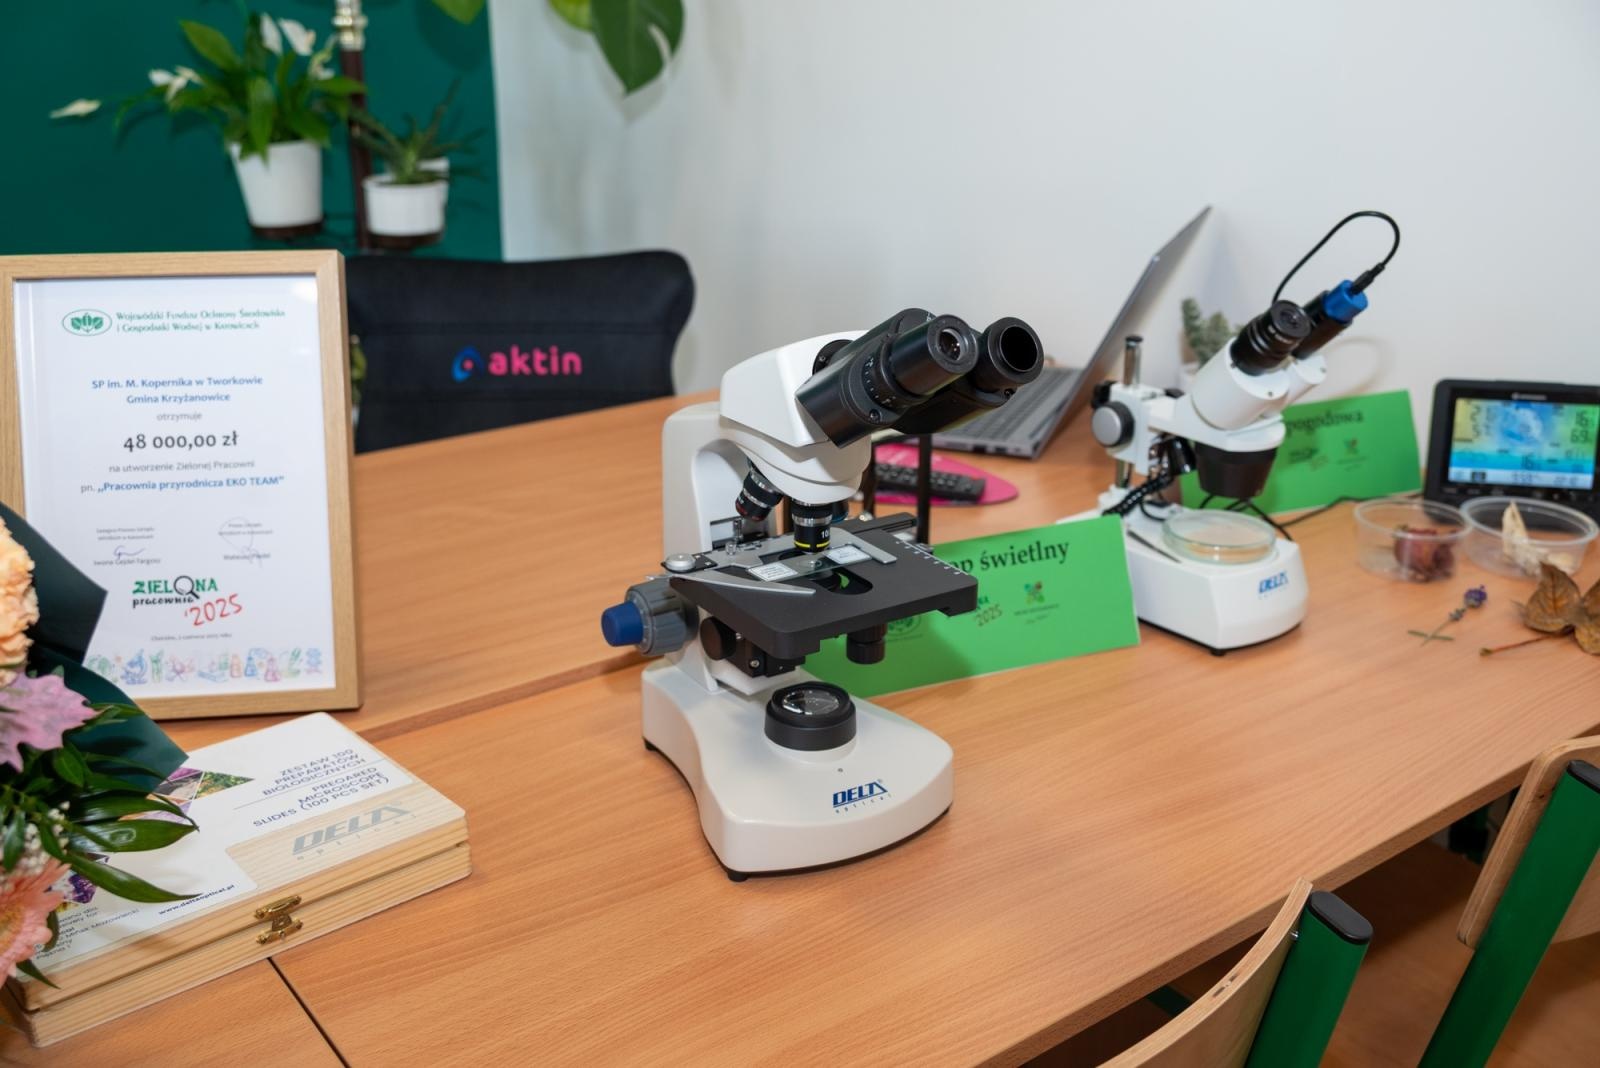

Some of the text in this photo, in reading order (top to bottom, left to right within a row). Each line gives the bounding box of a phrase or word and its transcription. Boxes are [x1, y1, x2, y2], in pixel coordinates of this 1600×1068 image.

[488, 344, 582, 376] aktin
[91, 380, 105, 389] SP
[107, 379, 122, 389] im.
[125, 379, 139, 388] M.
[141, 378, 193, 390] Kopernika
[207, 376, 262, 386] Tworkowie
[126, 393, 230, 405] Gmina Krzyżanowice
[156, 412, 202, 422] otrzymuje
[123, 430, 239, 453] 48 000,00 zł
[109, 460, 255, 473] na utworzenie Zielonej Pracowni
[80, 484, 94, 494] pn.
[159, 479, 223, 491] przyrodnicza
[226, 476, 247, 486] EKO
[980, 541, 1069, 571] świetlny
[274, 754, 359, 785] PREPARATÓW
[279, 748, 354, 776] ZESTAW 100
[262, 758, 367, 796] BIOLOGICZNYCH
[298, 771, 385, 804] MICROSCOPE
[252, 775, 389, 827] SLIDES (100 PCS SET)
[832, 781, 888, 808] DELTA
